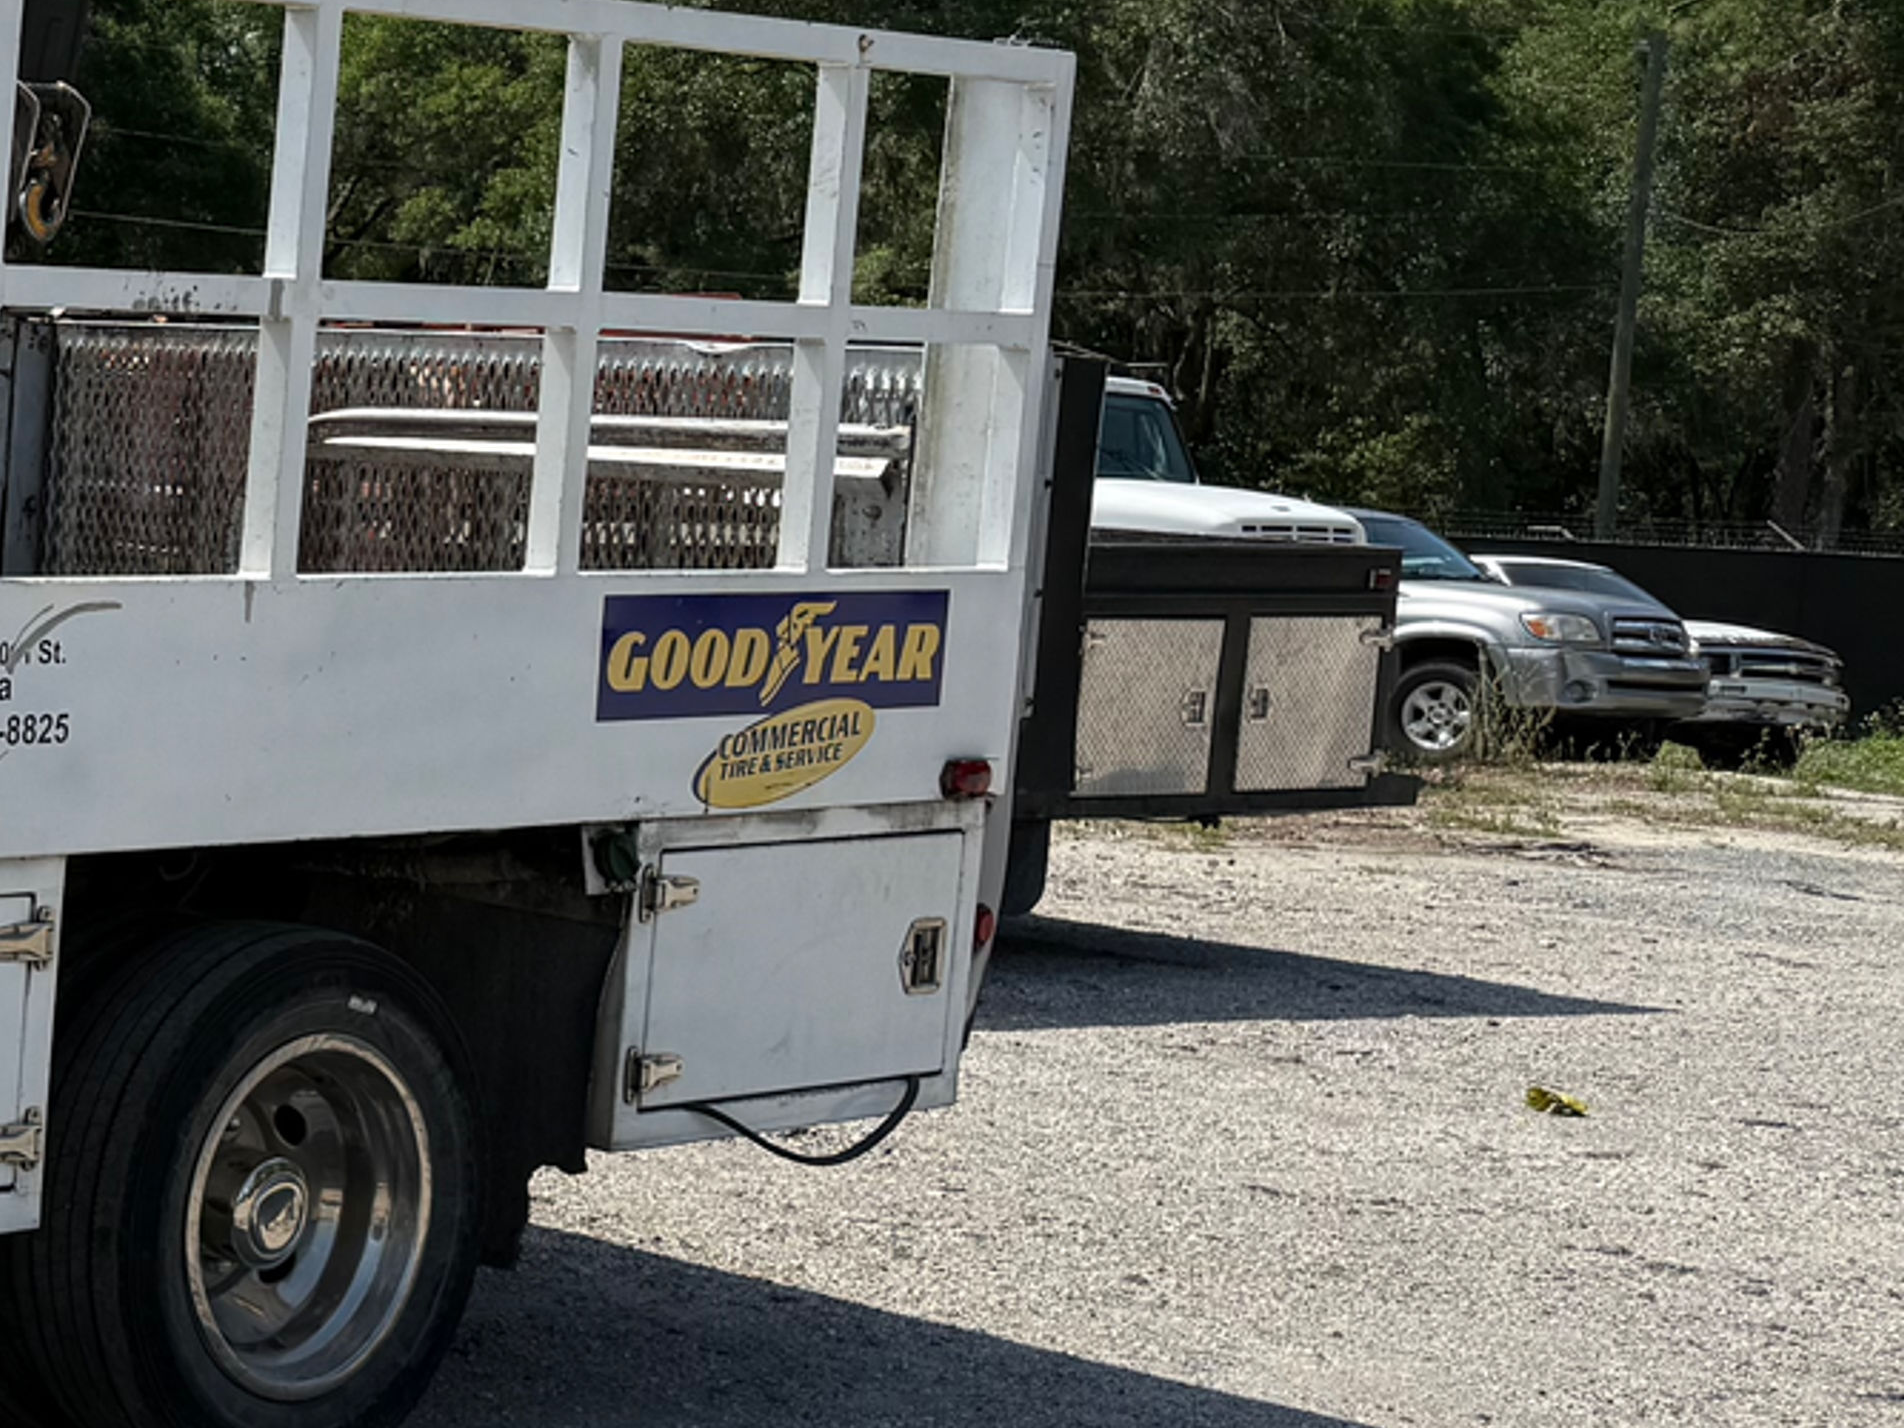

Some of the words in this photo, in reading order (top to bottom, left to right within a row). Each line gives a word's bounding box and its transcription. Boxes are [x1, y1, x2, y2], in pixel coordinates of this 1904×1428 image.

[38, 639, 67, 664] St.
[719, 711, 861, 760] COMMERCIAL
[720, 757, 758, 780] TIRE
[775, 743, 843, 769] SERVICE
